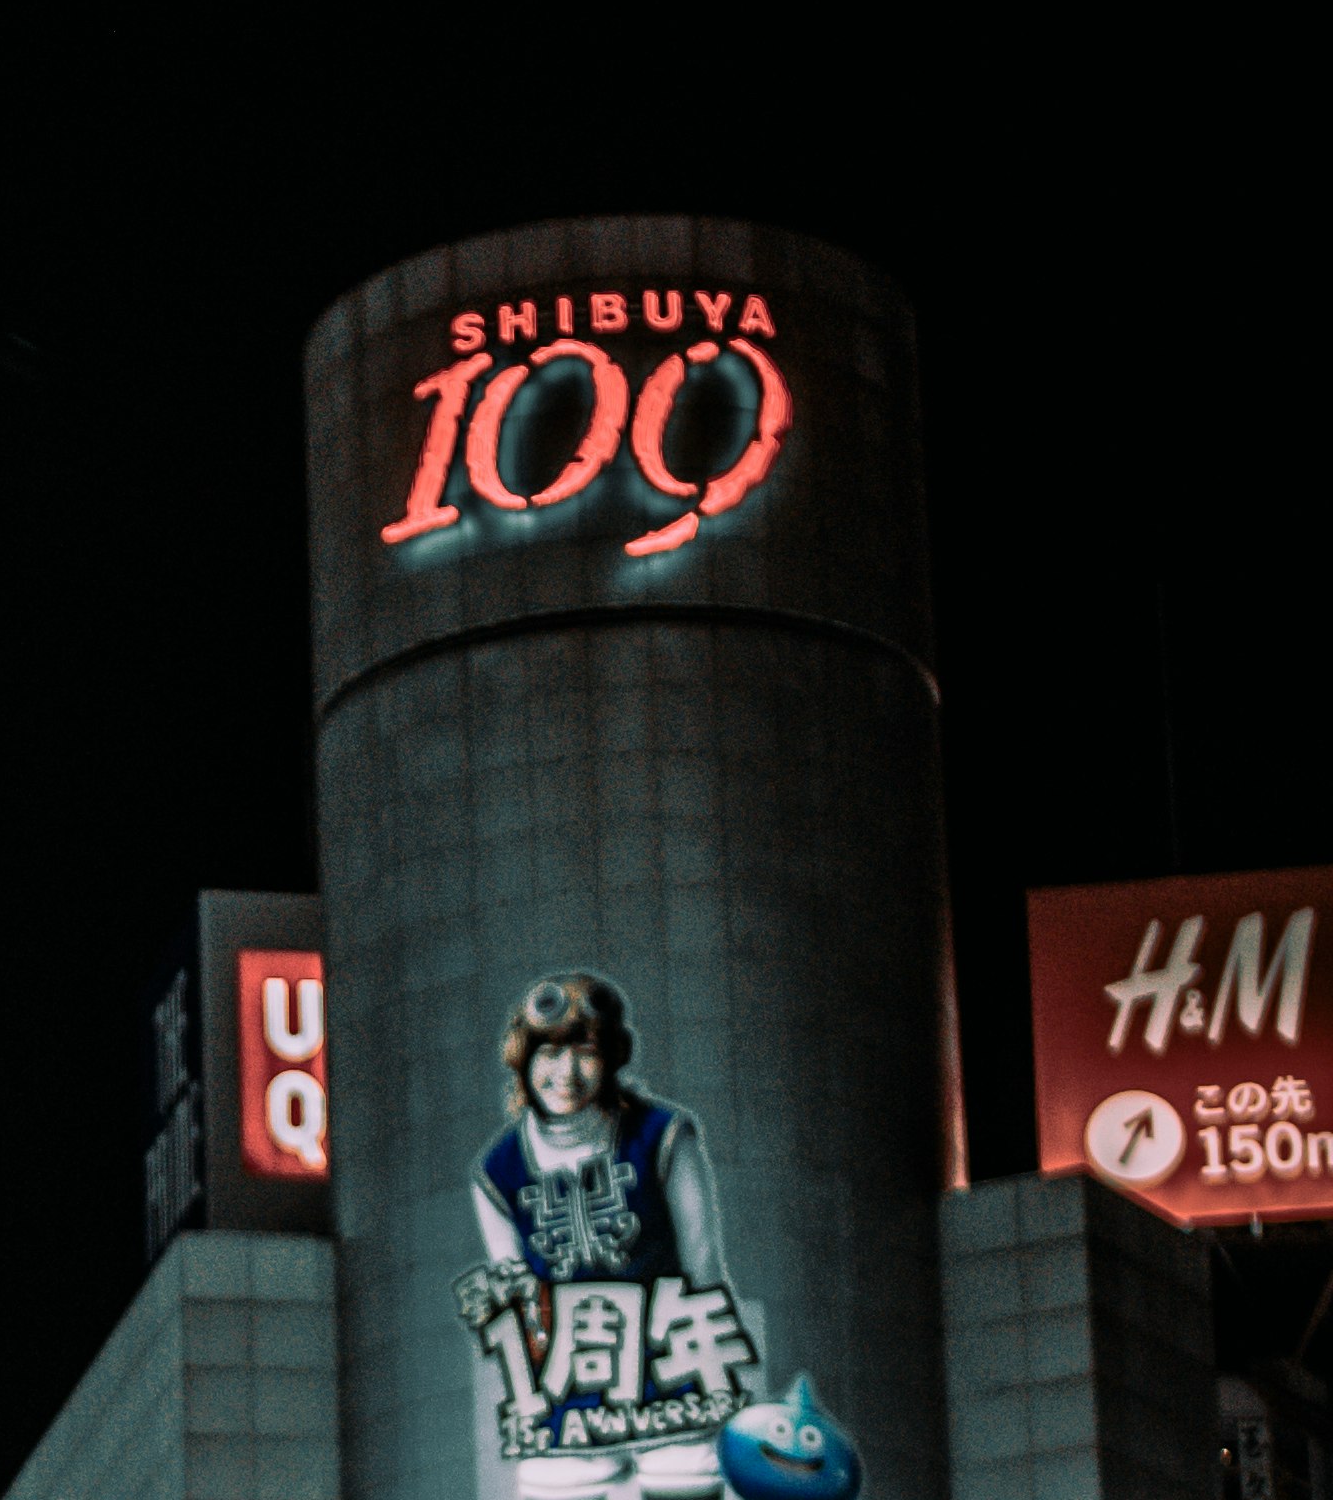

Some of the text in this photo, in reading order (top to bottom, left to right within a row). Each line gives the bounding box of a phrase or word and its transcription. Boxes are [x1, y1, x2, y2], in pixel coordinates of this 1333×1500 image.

[450, 290, 776, 355] SHIBUYA
[380, 338, 794, 558] 109
[1104, 905, 1316, 1060] H&M
[1194, 1076, 1313, 1120] この先
[483, 1276, 760, 1422] 1周年
